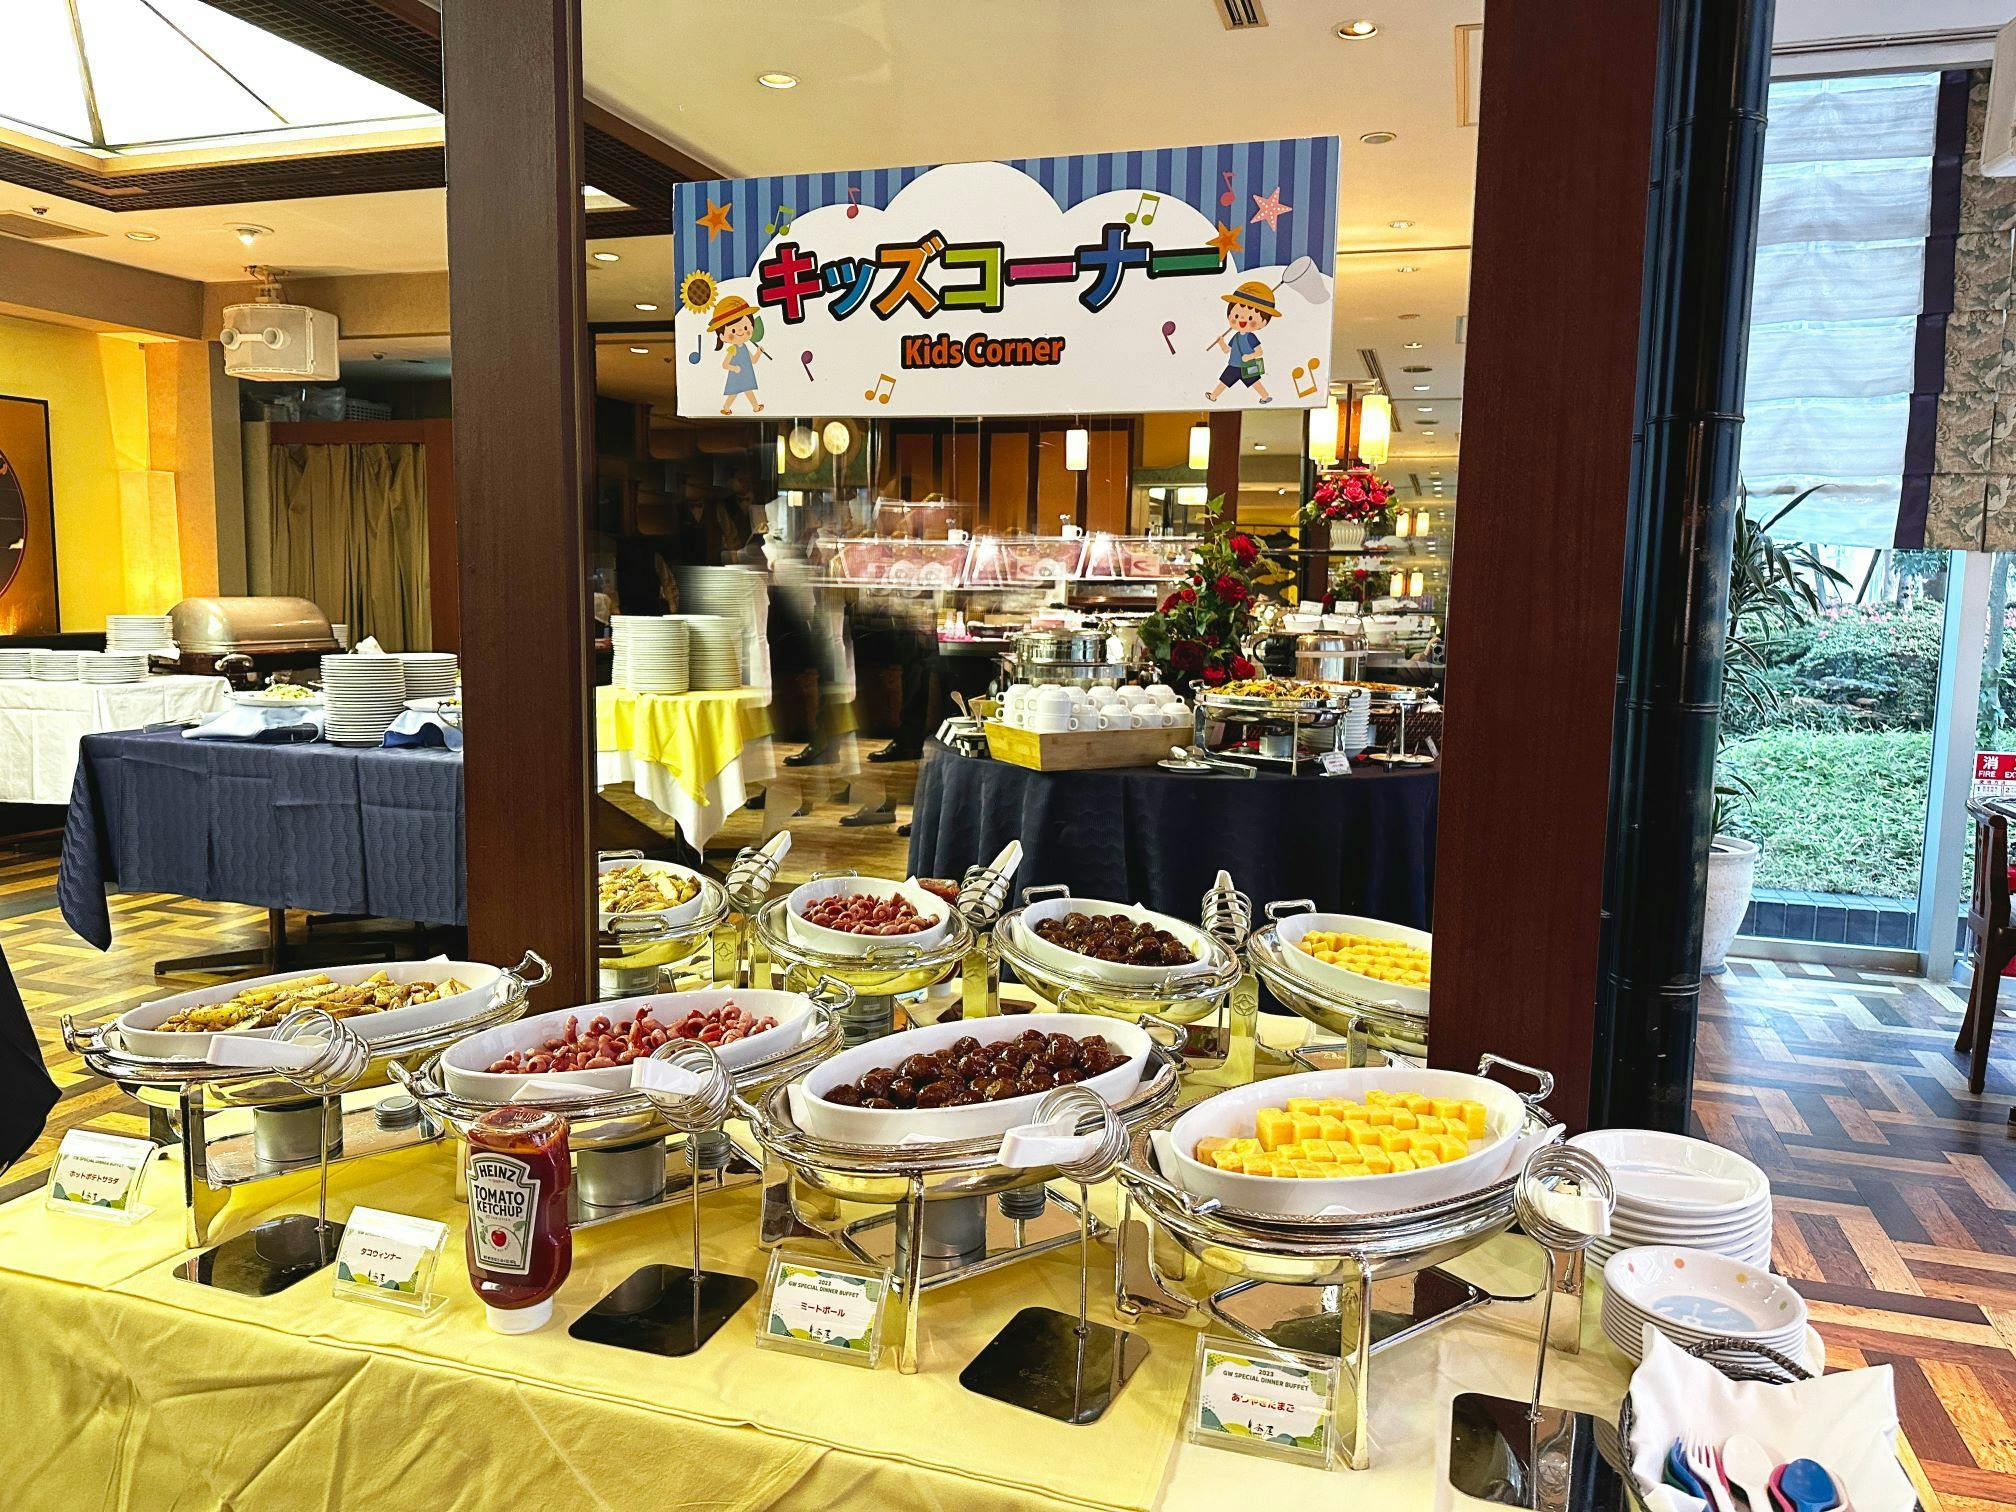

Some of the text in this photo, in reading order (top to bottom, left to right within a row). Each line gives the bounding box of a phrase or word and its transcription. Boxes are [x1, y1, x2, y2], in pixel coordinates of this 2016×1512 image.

[757, 222, 1228, 324] キッズコーナー
[901, 333, 1067, 369] Kids Corner
[1983, 756, 1999, 770] 消
[1978, 770, 1996, 778] FIRE
[478, 1164, 517, 1182] HEINZ
[474, 1184, 525, 1206] TOMATO
[476, 1199, 523, 1218] KETCHUP
[360, 1247, 402, 1261] タコウィンナー
[797, 1282, 819, 1292] SPECIAL
[819, 1286, 839, 1295] DINNER
[839, 1288, 860, 1299] BUFFET
[818, 1279, 832, 1287] 2023
[800, 1301, 846, 1318] ミートボール
[1222, 1370, 1309, 1392] GW SPECIAL DINNER BUFFET
